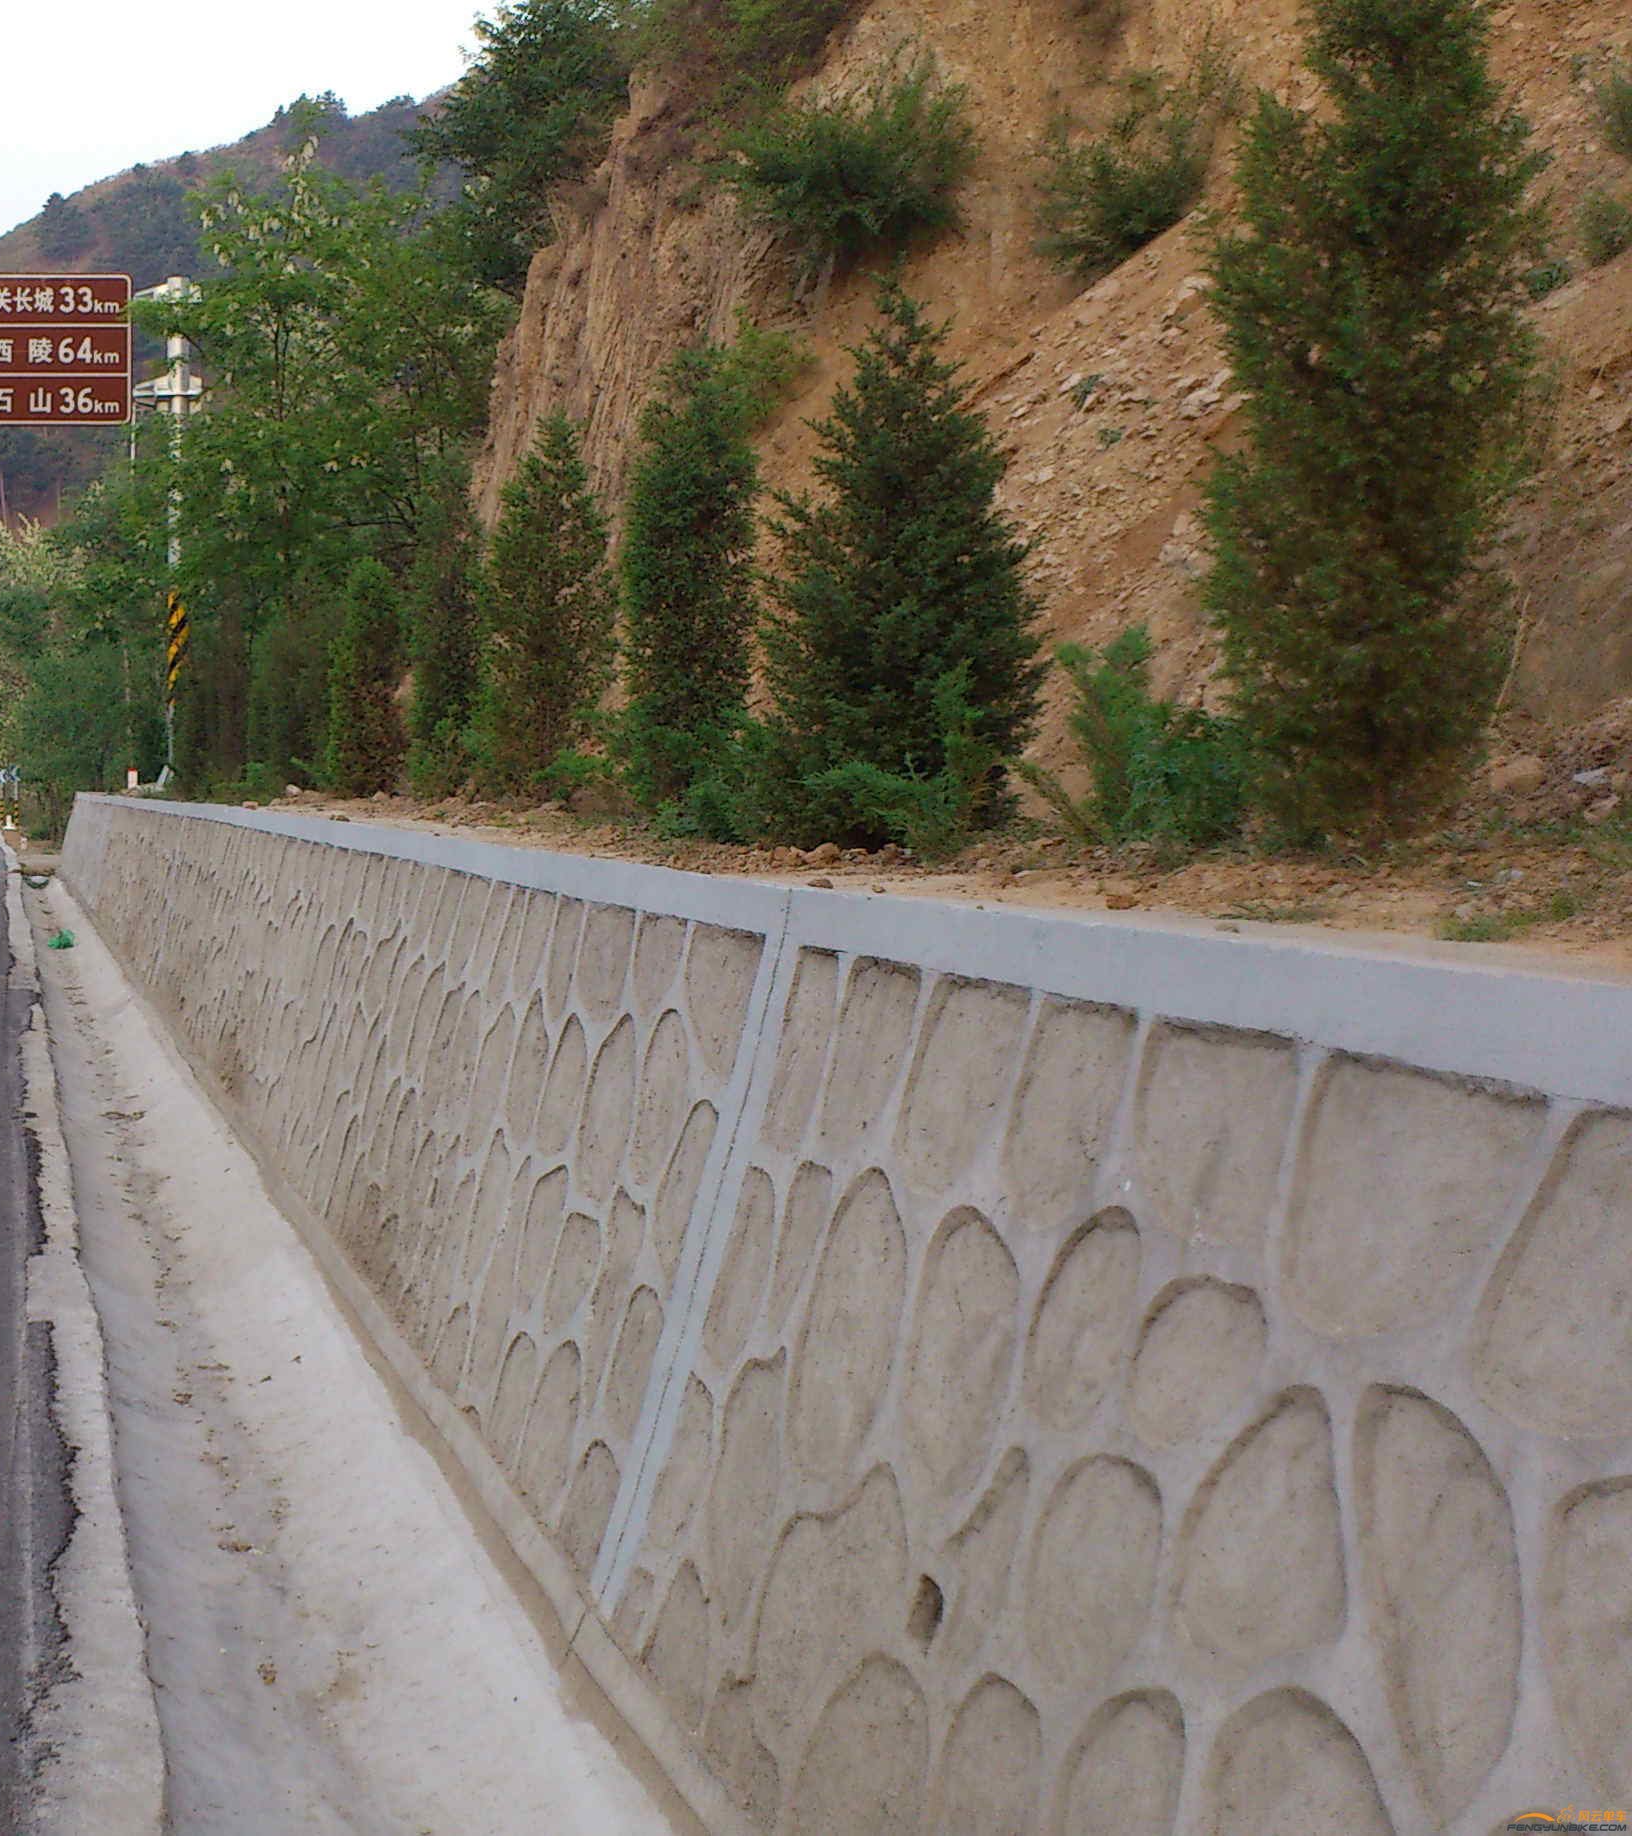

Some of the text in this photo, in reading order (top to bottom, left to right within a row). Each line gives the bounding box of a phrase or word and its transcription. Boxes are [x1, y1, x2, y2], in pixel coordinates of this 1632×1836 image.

[59, 287, 120, 314] 33km
[58, 337, 120, 364] 64km
[59, 387, 120, 414] 36km
